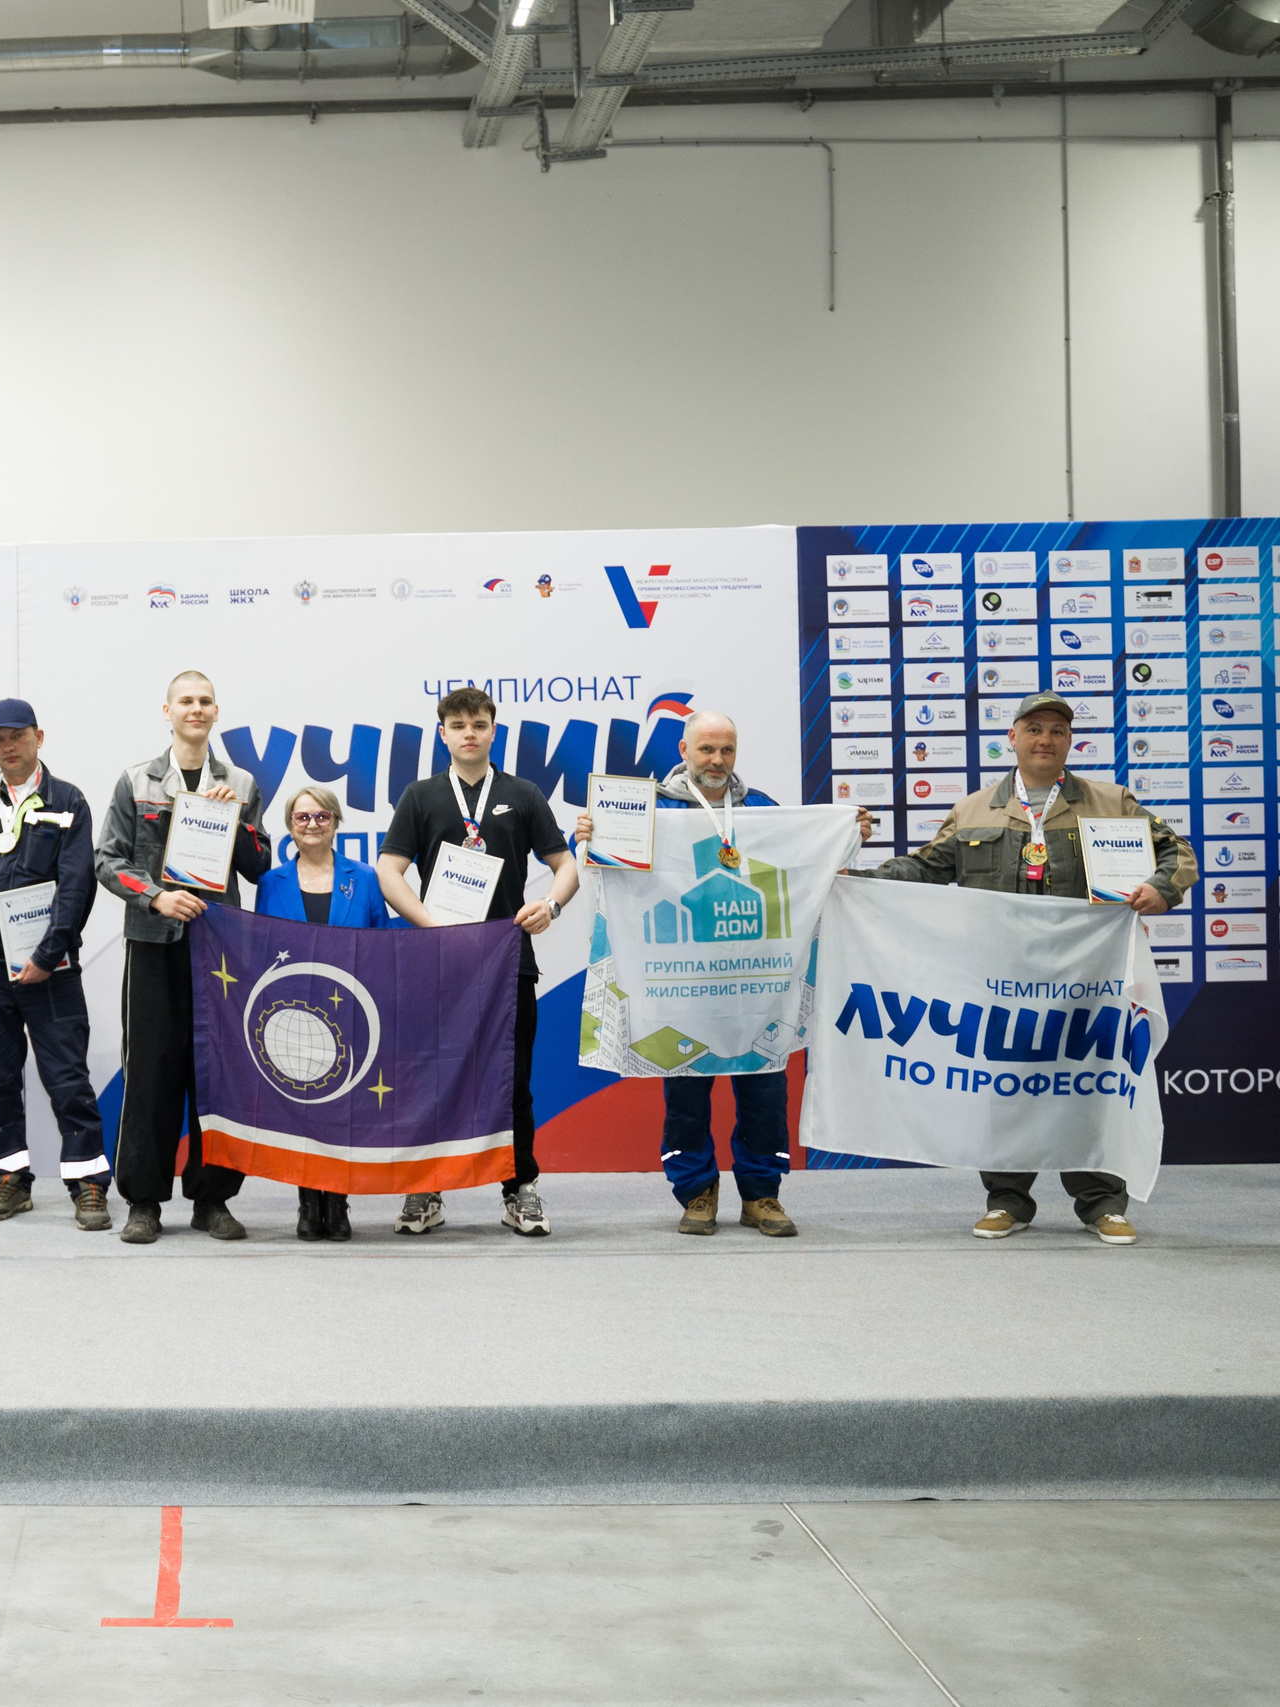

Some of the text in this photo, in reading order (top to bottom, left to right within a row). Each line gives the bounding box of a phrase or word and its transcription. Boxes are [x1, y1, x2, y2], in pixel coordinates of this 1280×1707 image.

[91, 593, 129, 601] МИНСТРОЙ
[229, 588, 270, 596] ШКОЛА
[229, 596, 255, 604] ЖКХ
[597, 800, 647, 811] ЛУЧШИЙ
[180, 816, 230, 833] ЛУЧШИЙ
[195, 828, 226, 838] ПРОФЕССИИ
[1092, 838, 1143, 848] ЛУЧШИЙ
[442, 869, 488, 889] ЛУЧШИЙ
[456, 883, 484, 895] ПРОФЕССИИ
[9, 904, 52, 923] ЛУЧШИЙ
[713, 900, 758, 917] НАШ
[714, 919, 759, 938] ДОМ
[645, 952, 793, 973] ГРУППА КОМПАНИЙ
[645, 981, 791, 998] ЖИЛСЕРВИС РЕУТОВ
[986, 978, 1125, 999] ЧЕМПИОНАТ
[884, 1054, 936, 1085] ПО
[1164, 1068, 1280, 1095] КОТОР
